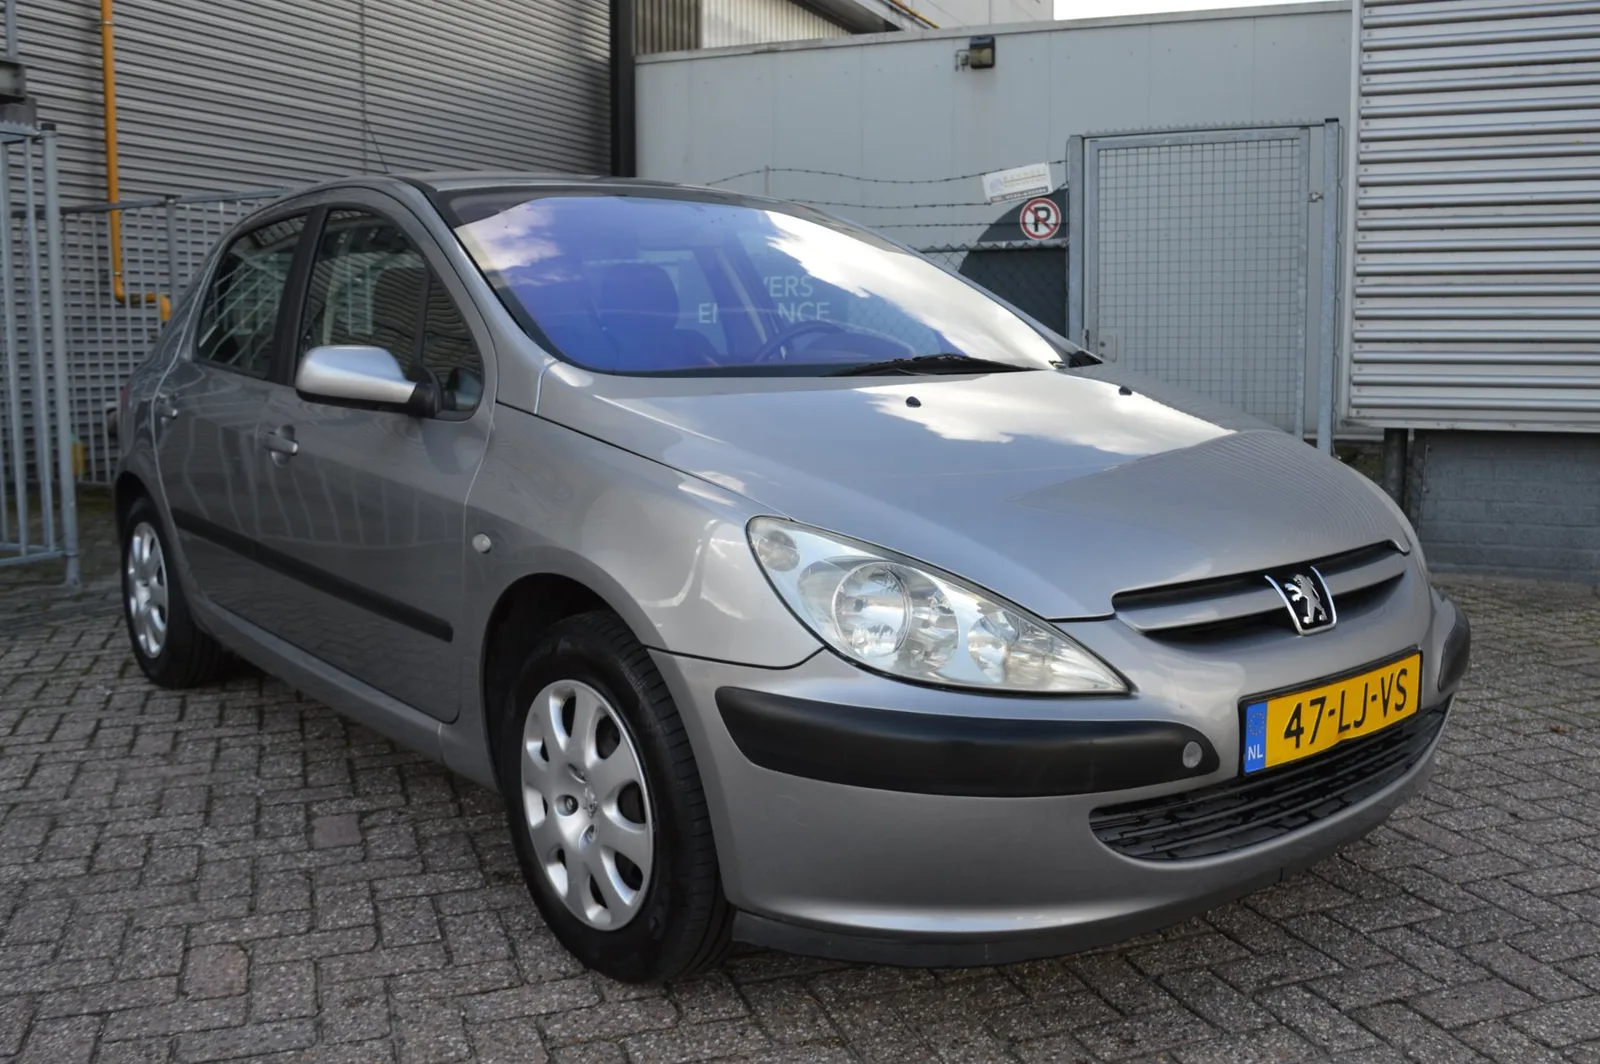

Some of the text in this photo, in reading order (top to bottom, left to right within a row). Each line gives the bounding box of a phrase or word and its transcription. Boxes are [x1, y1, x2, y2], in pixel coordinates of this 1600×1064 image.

[764, 276, 814, 297] ERS
[1283, 668, 1408, 749] 47-LJ-VS
[1247, 743, 1264, 761] NL
